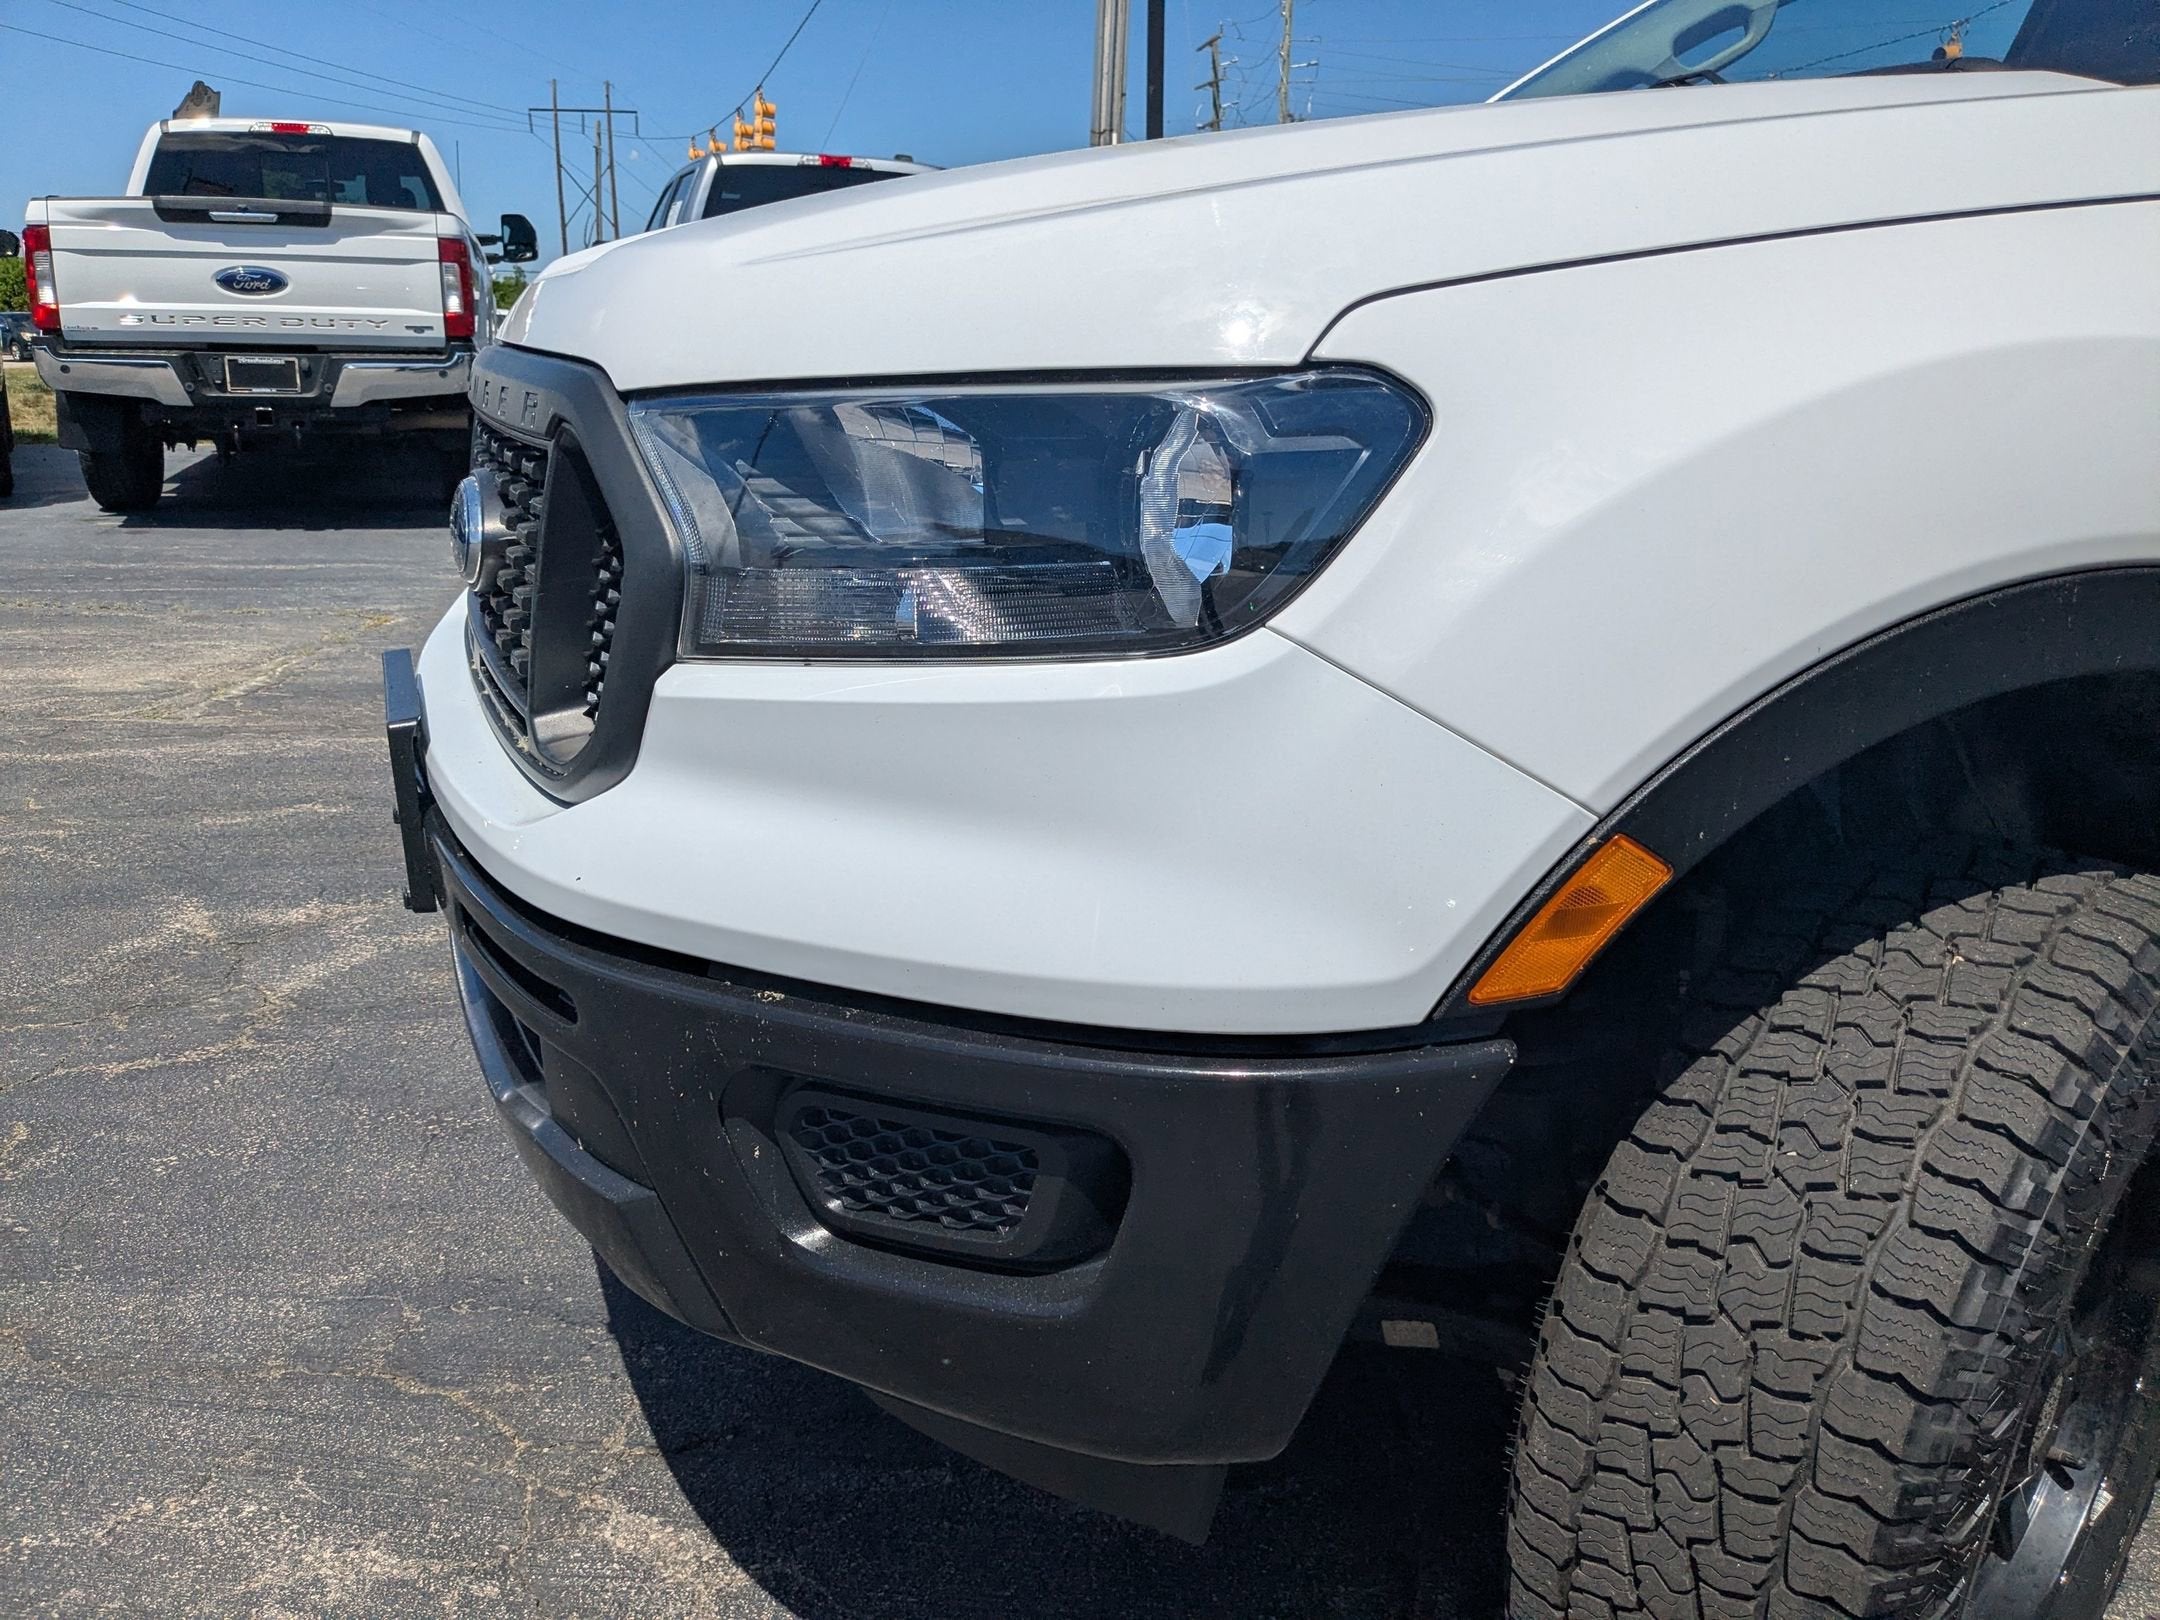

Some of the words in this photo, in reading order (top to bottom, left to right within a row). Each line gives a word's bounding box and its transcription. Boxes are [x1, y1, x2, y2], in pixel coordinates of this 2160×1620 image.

[233, 273, 271, 290] Ford
[119, 314, 267, 328] SUPER
[280, 317, 389, 330] DUTY
